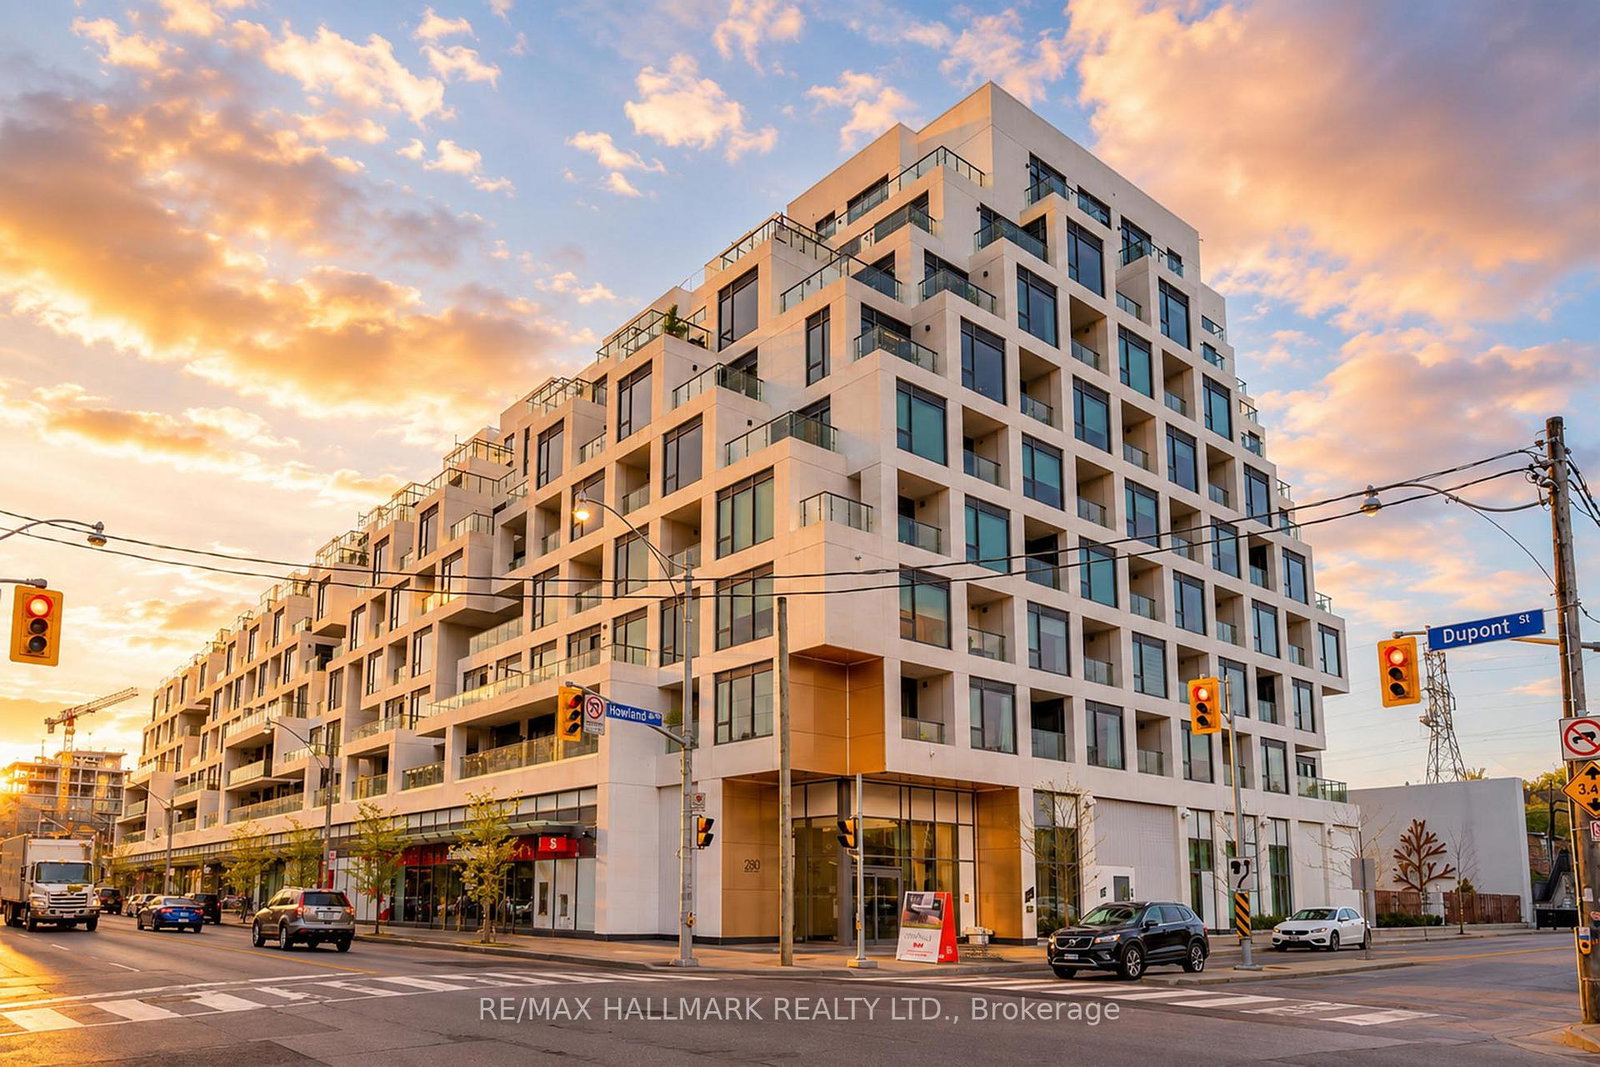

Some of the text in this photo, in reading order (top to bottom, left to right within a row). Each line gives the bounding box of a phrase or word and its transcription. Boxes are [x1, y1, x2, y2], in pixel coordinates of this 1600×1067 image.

[1443, 614, 1530, 644] Dupont St
[609, 704, 647, 722] Howland
[1578, 783, 1599, 795] 3.4
[744, 859, 760, 871] 280
